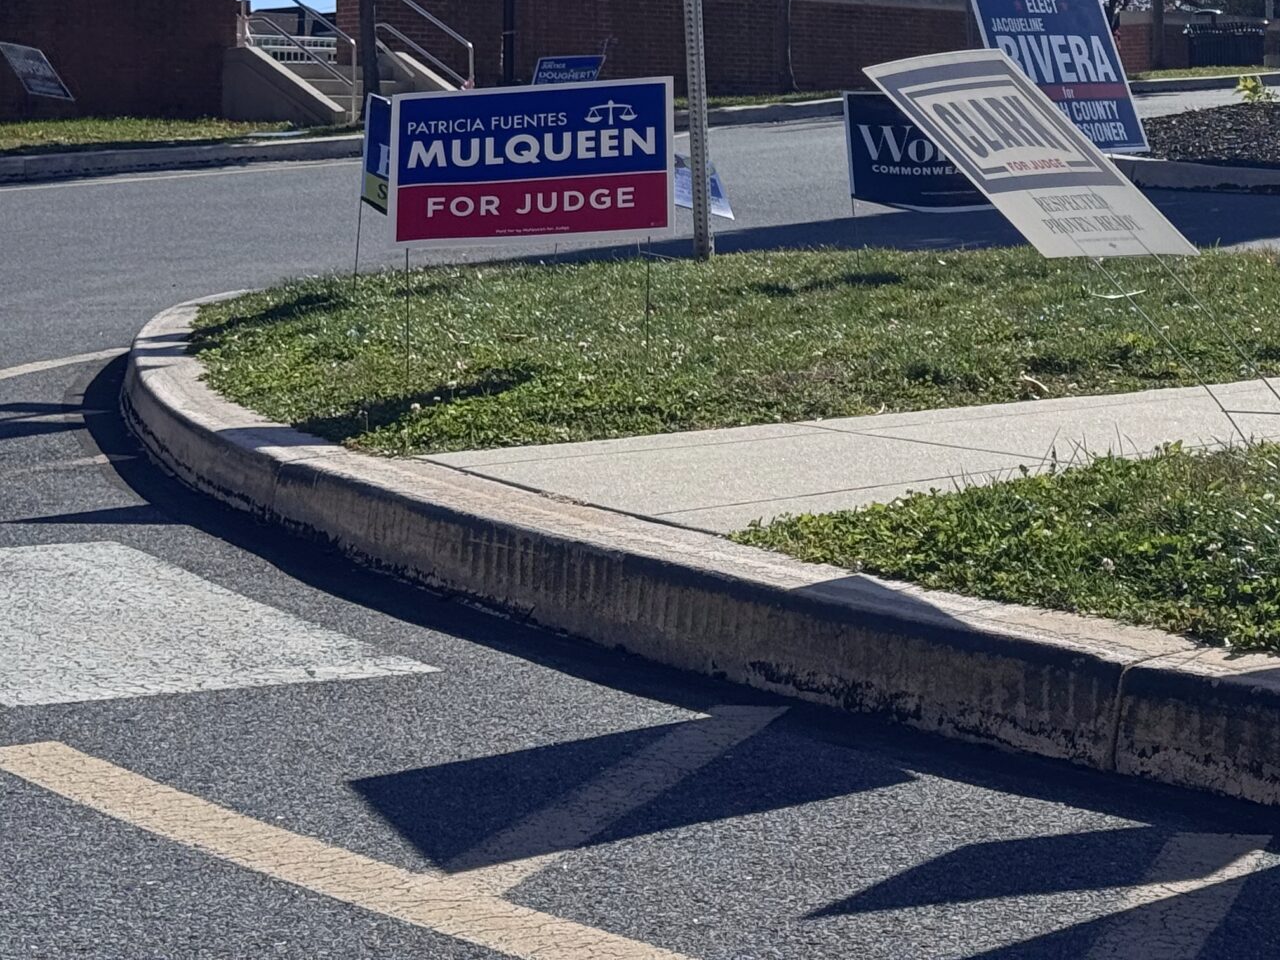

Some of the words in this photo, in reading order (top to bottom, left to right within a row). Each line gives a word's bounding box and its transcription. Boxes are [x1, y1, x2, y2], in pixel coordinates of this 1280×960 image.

[991, 18, 1045, 33] JACQUELINE
[995, 35, 1118, 83] RIVERA
[538, 69, 598, 80] DOUGHERTY
[1062, 86, 1075, 99] for
[1071, 100, 1119, 121] COUNTY
[407, 117, 485, 136] PATRICIA
[491, 112, 567, 131] FUENTES
[933, 96, 1072, 158] CLARK
[1077, 122, 1129, 142] SIONER
[407, 126, 656, 168] MULQUEEN
[1006, 161, 1031, 172] FOR
[1032, 158, 1067, 170] JUDGE
[426, 196, 500, 218] FOR
[515, 187, 636, 215] JUDGE
